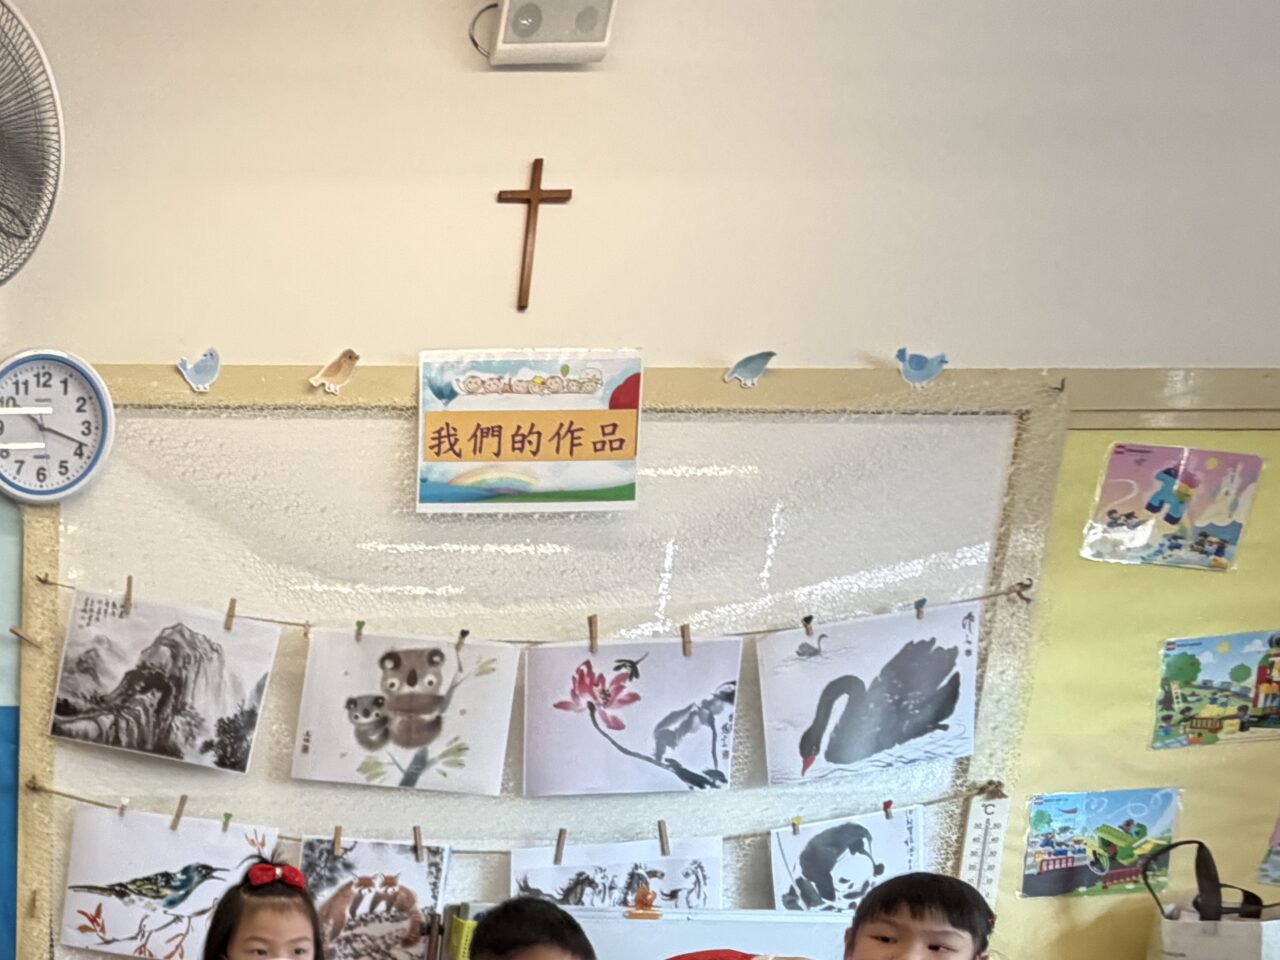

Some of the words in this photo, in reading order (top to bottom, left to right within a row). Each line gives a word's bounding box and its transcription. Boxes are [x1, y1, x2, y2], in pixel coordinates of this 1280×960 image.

[12, 379, 29, 395] 11
[33, 371, 52, 388] 12
[60, 378, 68, 395] 1
[76, 396, 86, 413] 2
[81, 420, 92, 437] 3
[428, 420, 626, 459] 我們的作品
[14, 460, 25, 476] 7
[36, 467, 47, 483] 6
[58, 460, 69, 476] 5
